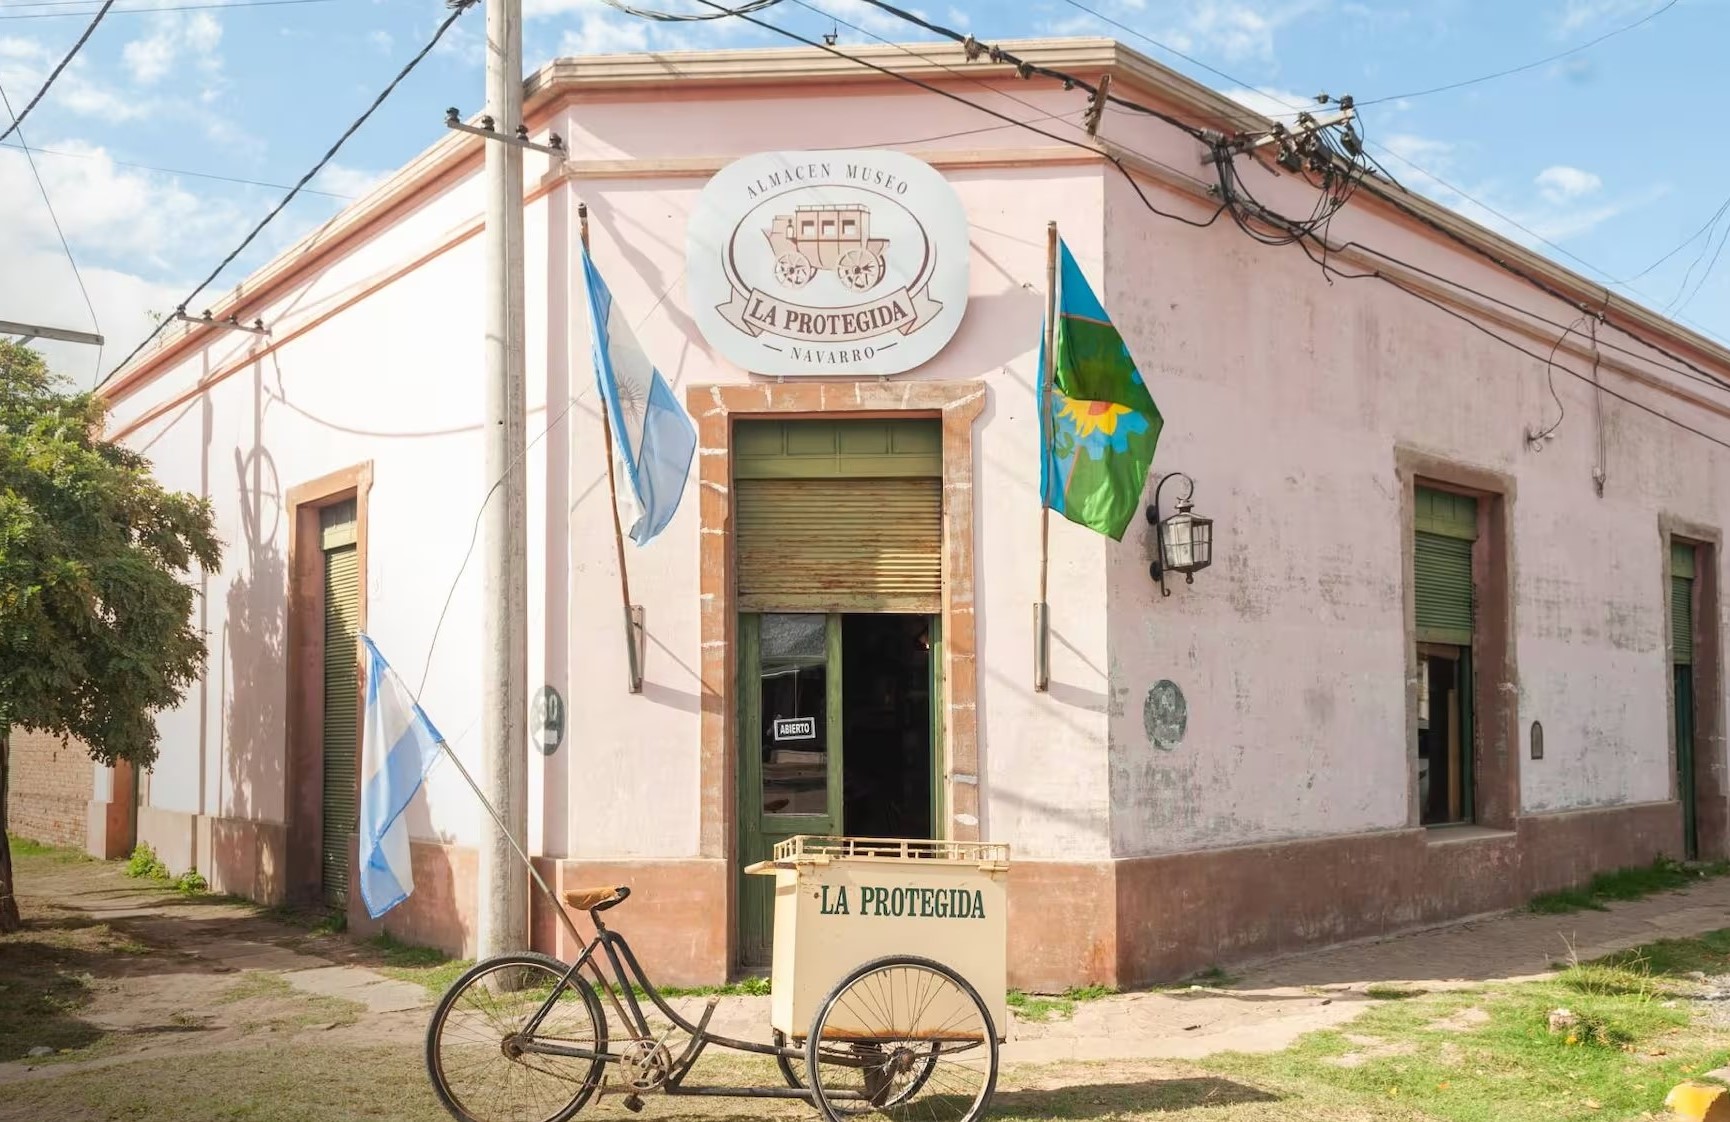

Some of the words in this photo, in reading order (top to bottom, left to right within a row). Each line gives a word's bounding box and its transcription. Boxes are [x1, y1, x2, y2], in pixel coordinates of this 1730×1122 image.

[747, 163, 830, 199] ALMACEN
[846, 164, 908, 195] MUSEO
[749, 298, 777, 327] LA
[783, 300, 908, 335] PROTEGIDA
[790, 346, 875, 364] NAVARRO
[780, 722, 810, 735] ABIERTO
[820, 885, 850, 915] LA
[860, 886, 986, 919] PROTEGIDA
